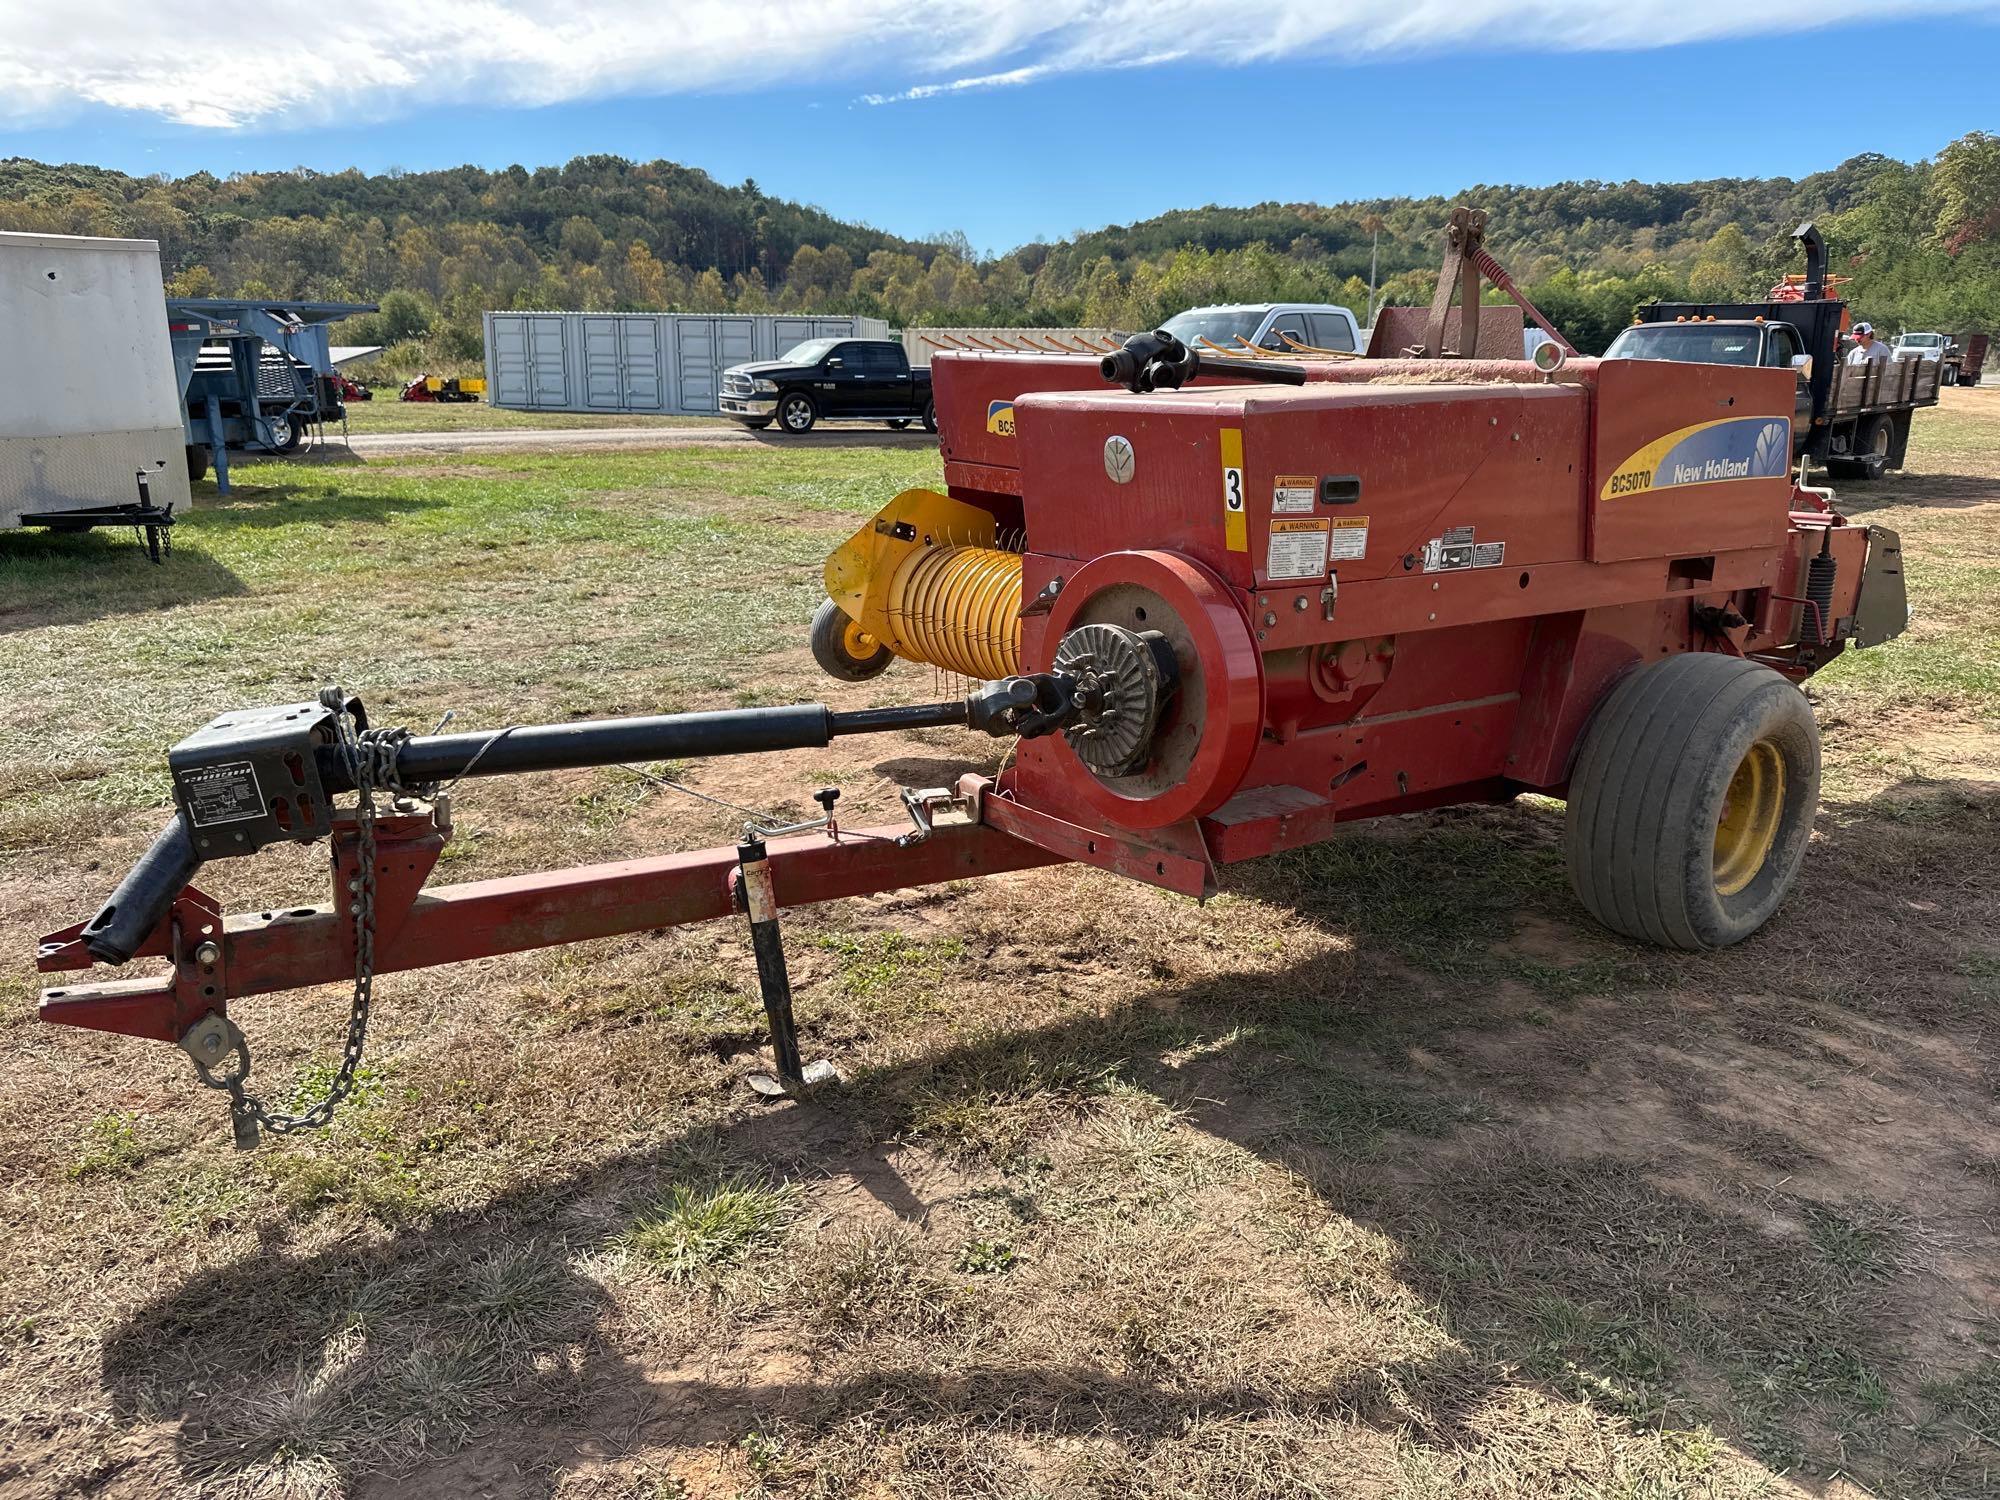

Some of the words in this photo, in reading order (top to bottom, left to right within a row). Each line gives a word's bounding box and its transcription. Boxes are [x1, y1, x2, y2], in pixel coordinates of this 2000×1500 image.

[1611, 470, 1651, 494] BC5070
[1673, 464, 1702, 484] New
[1704, 457, 1750, 480] Holland
[1227, 469, 1242, 510] 3
[1289, 521, 1320, 530] WARNING
